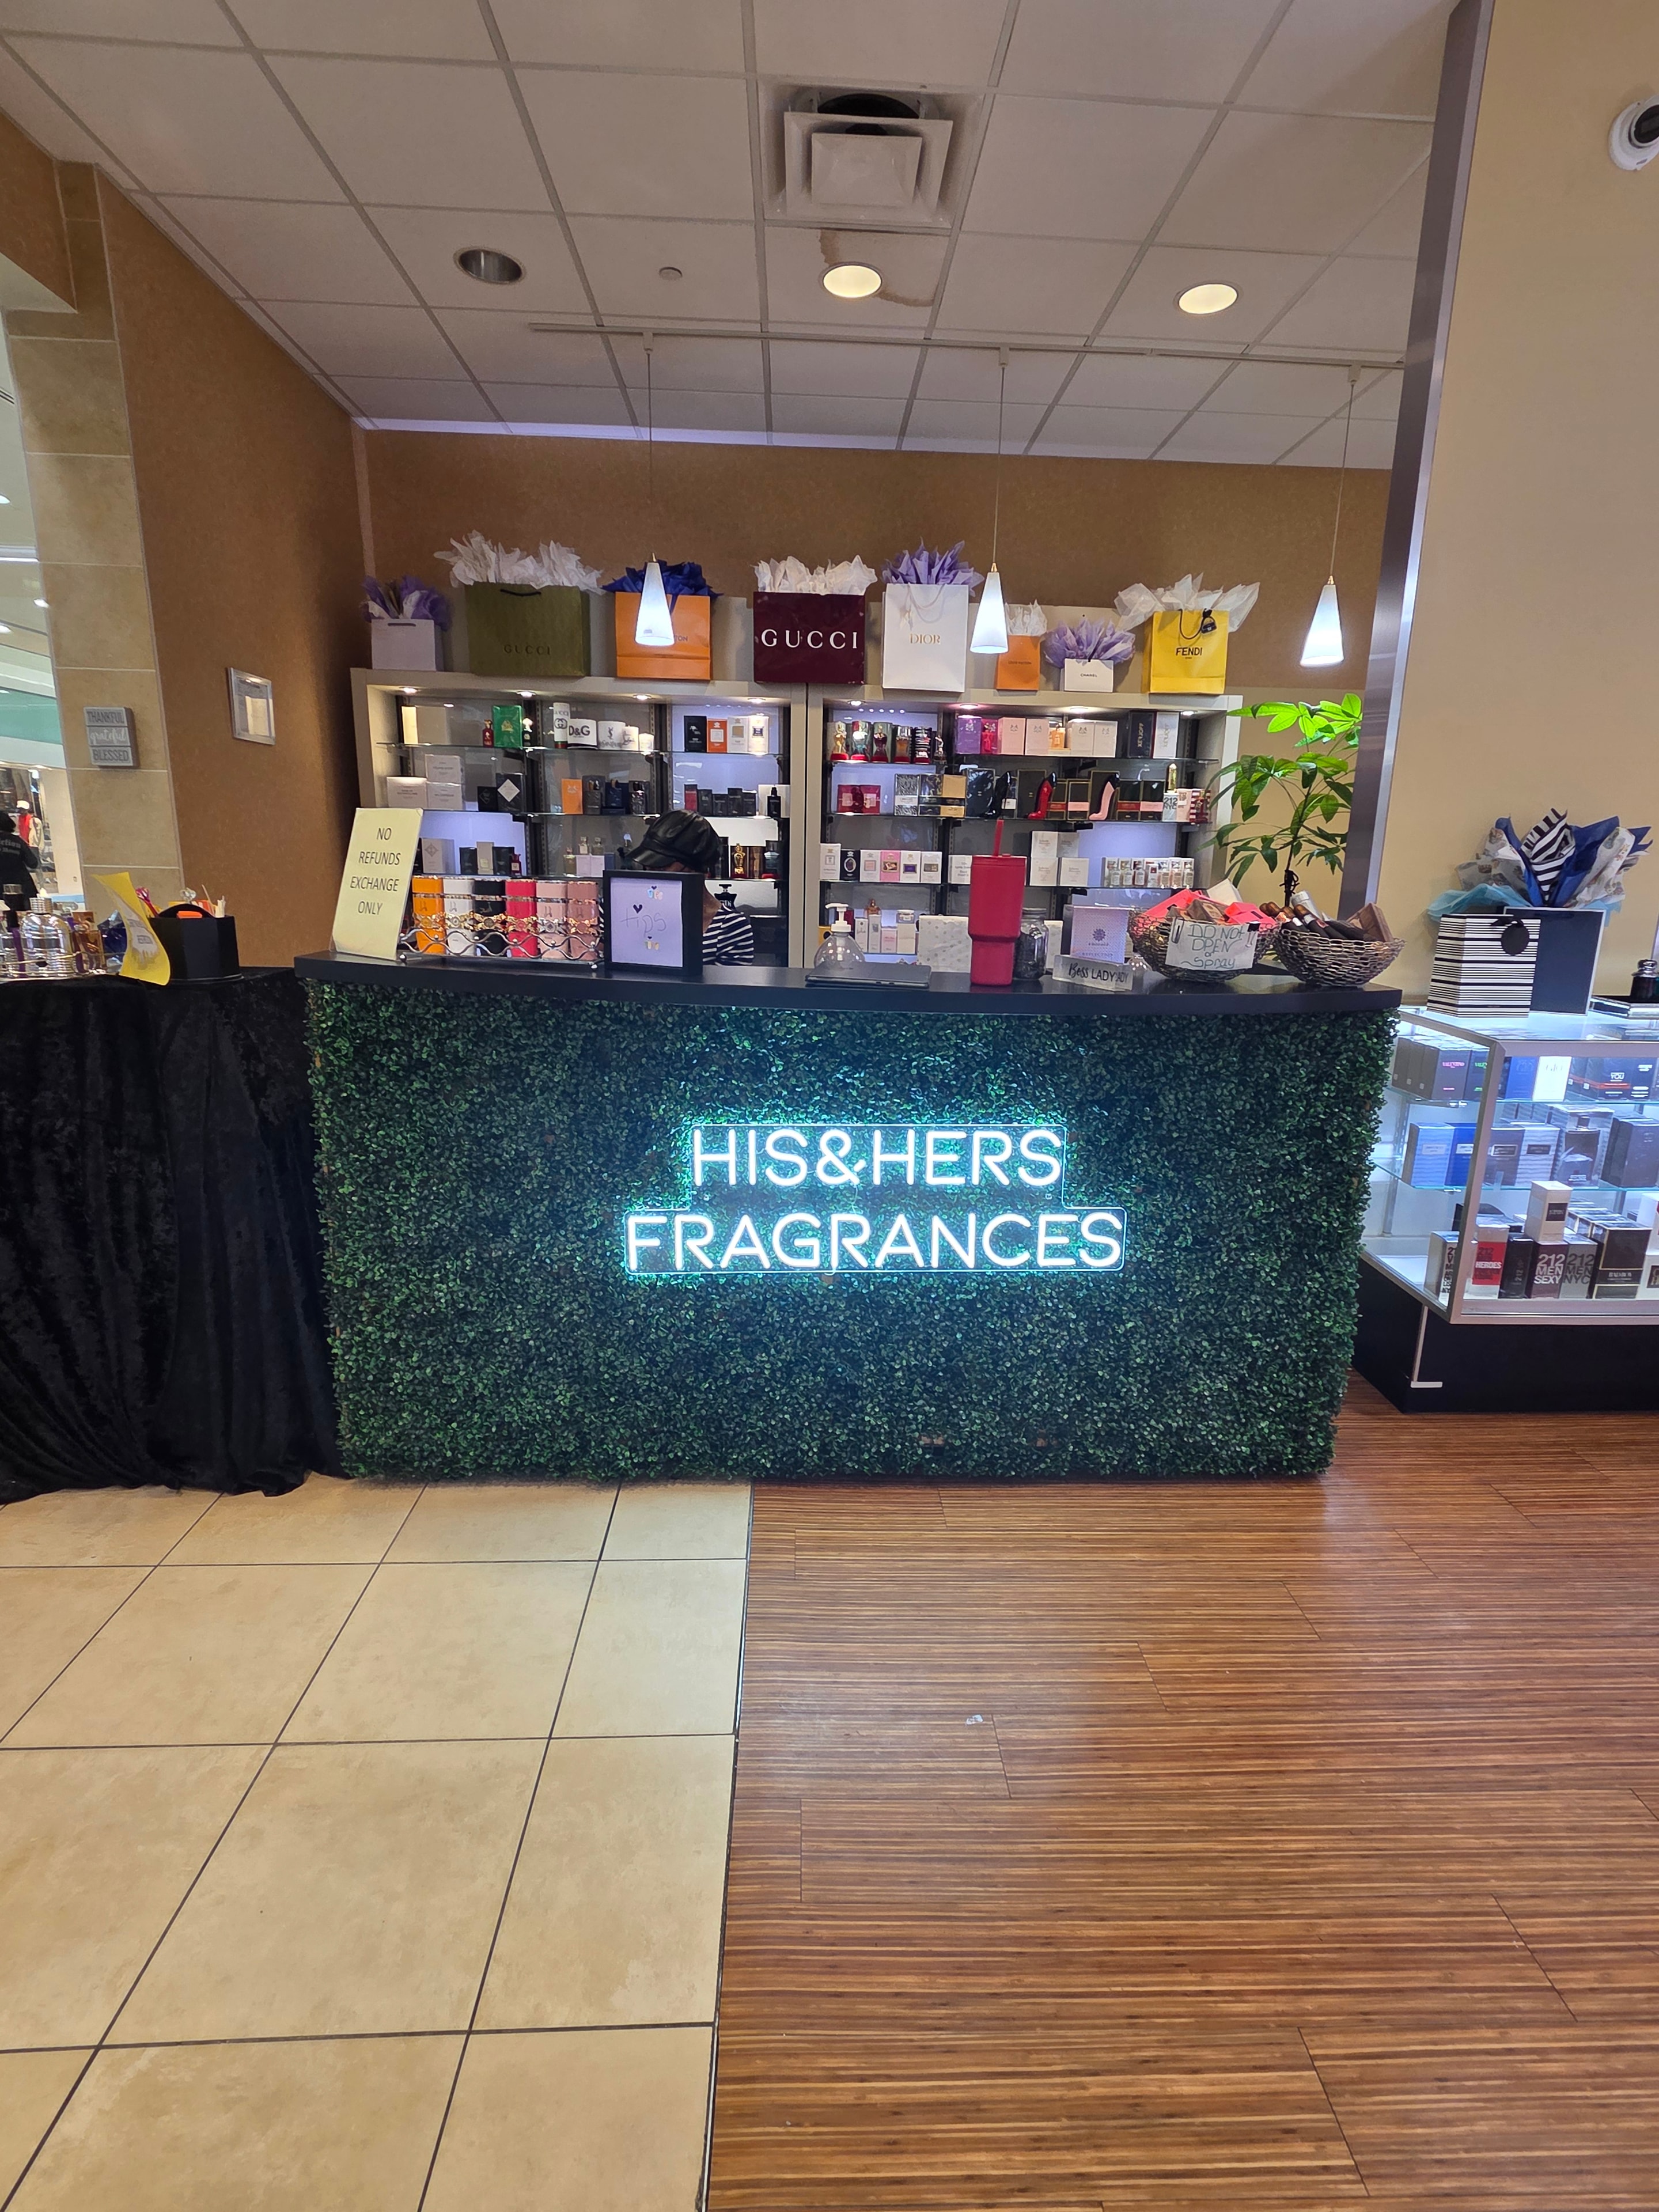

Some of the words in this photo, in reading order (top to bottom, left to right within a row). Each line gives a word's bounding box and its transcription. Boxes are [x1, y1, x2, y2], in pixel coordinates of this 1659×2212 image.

[761, 628, 858, 649] GUCCI
[908, 634, 940, 645] DIOR
[504, 644, 550, 655] GUCCI
[1176, 647, 1203, 656] FENDI
[86, 711, 125, 724] THANKFUL
[569, 725, 590, 736] D&G
[93, 749, 130, 762] BLESSED
[1164, 797, 1178, 805] 212
[376, 827, 392, 841] NO
[358, 851, 401, 865] REFUNDS
[350, 876, 400, 892] EXCHANGE
[358, 901, 382, 915] ONLY
[1188, 924, 1217, 938] DO
[1192, 938, 1243, 952] OPEN
[1092, 969, 1116, 982] LADY
[692, 1128, 1063, 1187] HIS&HERS
[627, 1213, 1123, 1270] FRAGRANCES
[1537, 1253, 1566, 1267] 212
[1567, 1253, 1595, 1266] 212
[1535, 1266, 1563, 1275] MEN
[1566, 1266, 1593, 1275] MEN
[1533, 1275, 1562, 1284] SEXY
[1563, 1274, 1590, 1285] NYC
